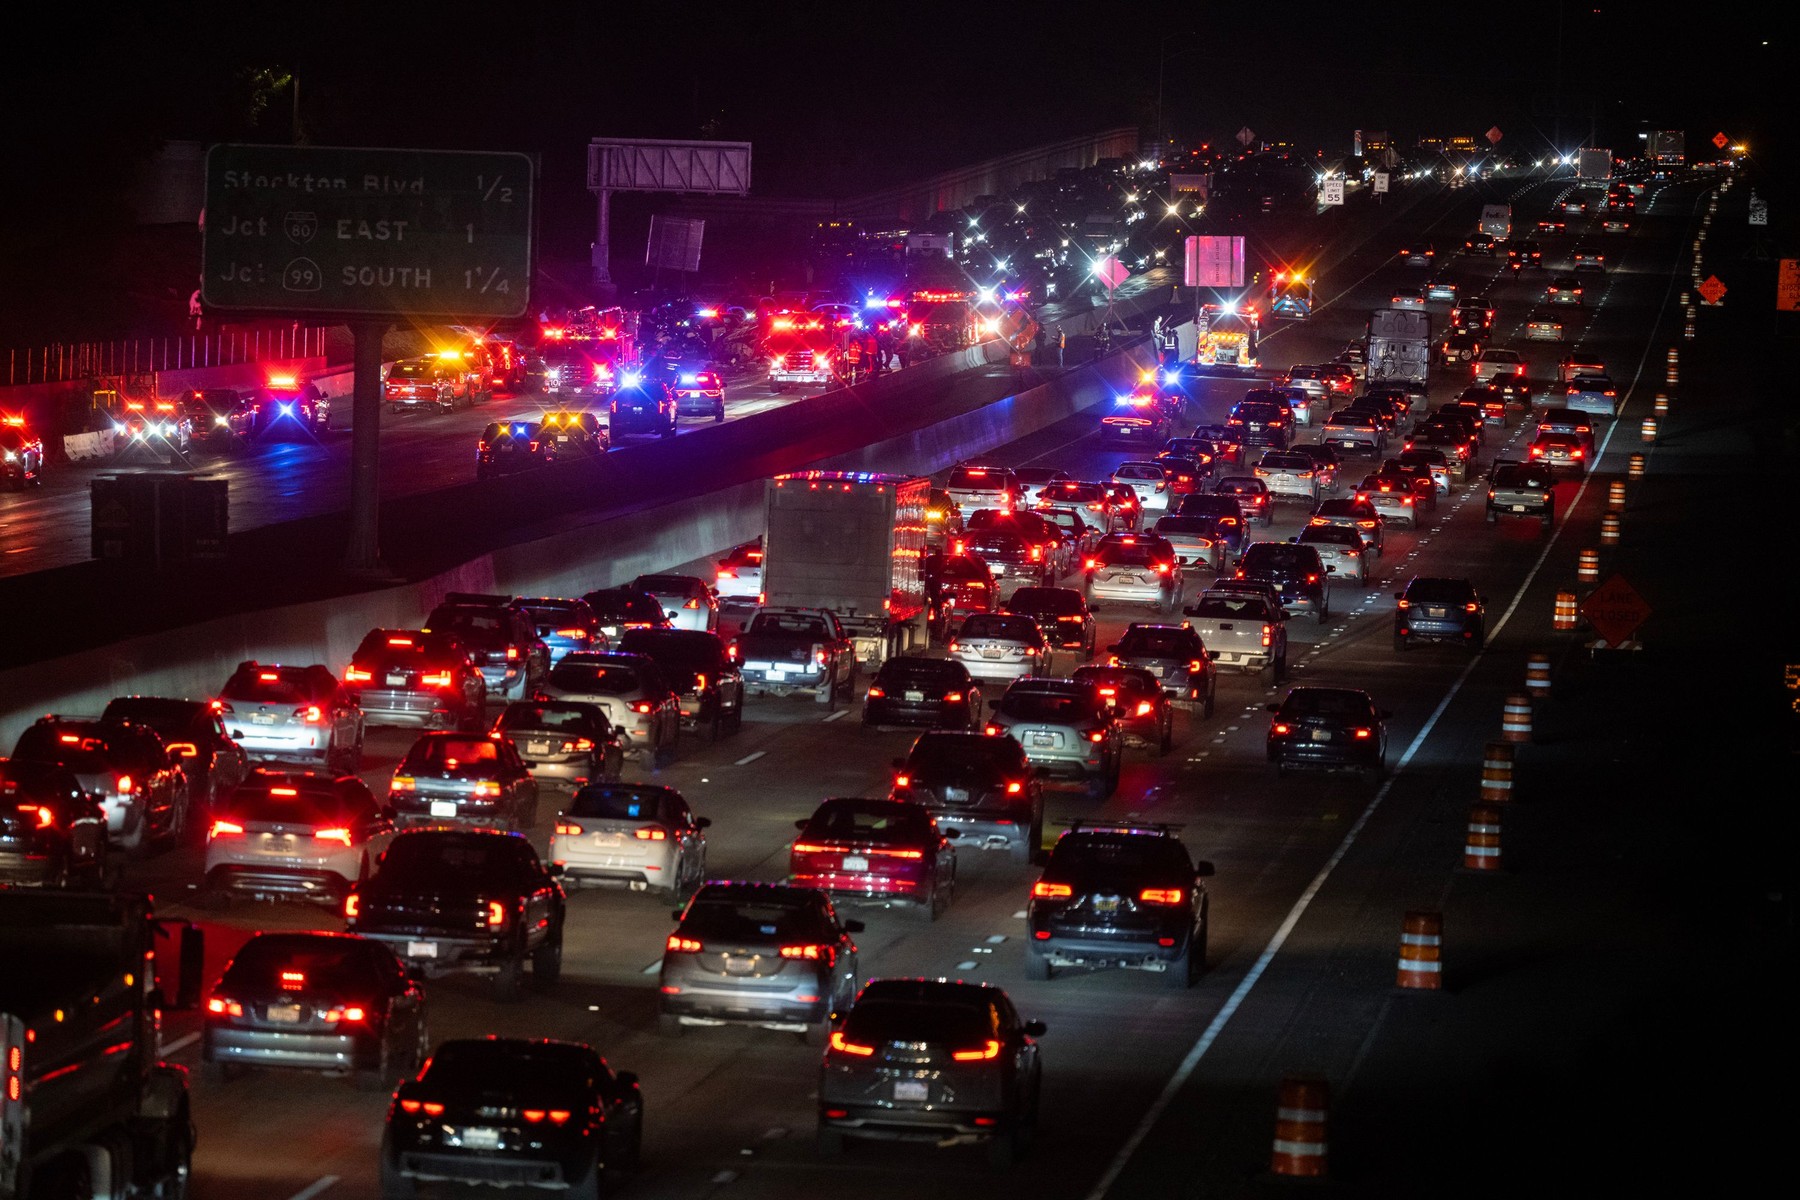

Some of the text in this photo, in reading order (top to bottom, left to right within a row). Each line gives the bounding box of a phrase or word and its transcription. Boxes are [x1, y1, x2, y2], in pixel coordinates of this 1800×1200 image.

[224, 170, 347, 193] Stockton
[364, 174, 424, 195] Blvd
[1486, 211, 1505, 219] FedEx
[222, 215, 474, 244] Jct 80 EAST 1
[291, 270, 314, 286] 99
[342, 265, 431, 288] SOUTH
[1600, 591, 1632, 603] LANE
[1592, 609, 1640, 622] CLOSED
